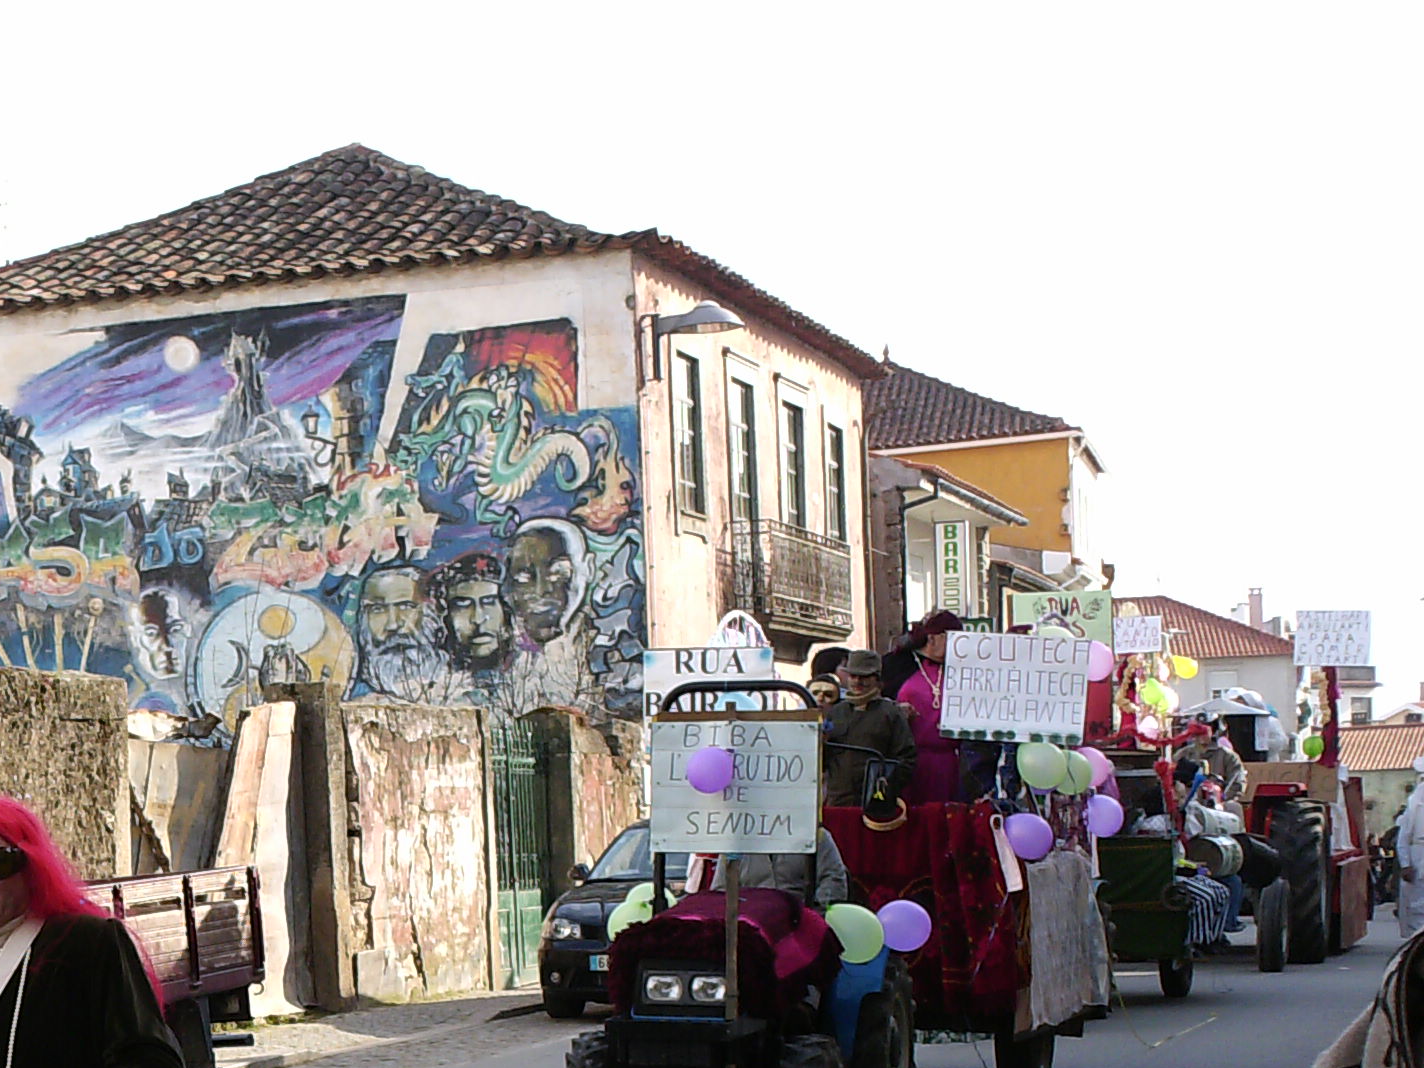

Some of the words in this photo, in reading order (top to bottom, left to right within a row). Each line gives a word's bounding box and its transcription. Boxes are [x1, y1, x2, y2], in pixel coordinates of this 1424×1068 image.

[943, 524, 959, 575] BAR
[674, 648, 746, 675] RUA
[683, 723, 772, 748] BIBA
[723, 786, 749, 803] DE
[686, 811, 793, 836] SENDIM
